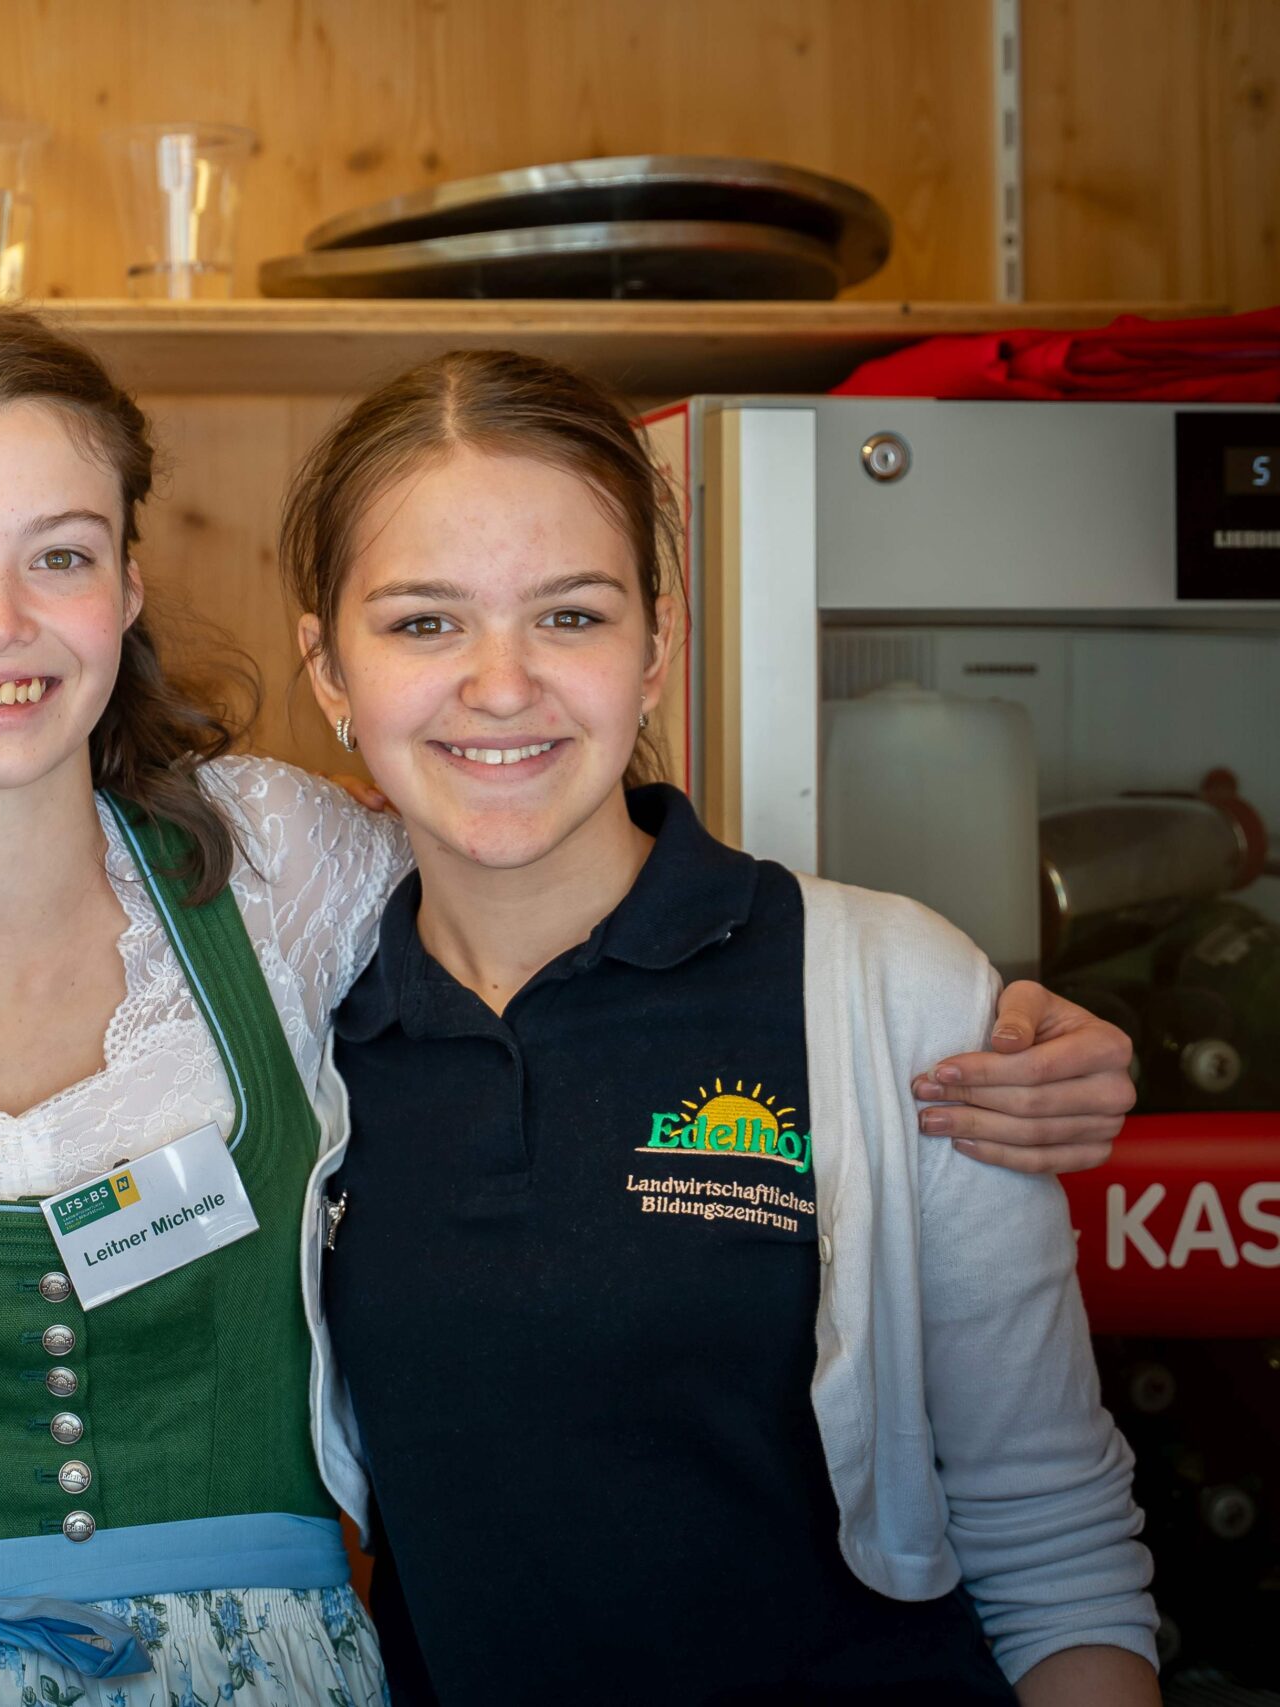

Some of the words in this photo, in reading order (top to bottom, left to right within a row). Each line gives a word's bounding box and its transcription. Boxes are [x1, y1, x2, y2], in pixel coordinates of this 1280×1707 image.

[58, 1186, 110, 1217] LFS+BS
[626, 1174, 816, 1215] Landwirtschaftliches
[641, 1196, 799, 1233] Bildungszentrum
[83, 1229, 149, 1267] Leitner
[150, 1193, 226, 1237] Michelle
[1106, 1181, 1280, 1271] KAS
